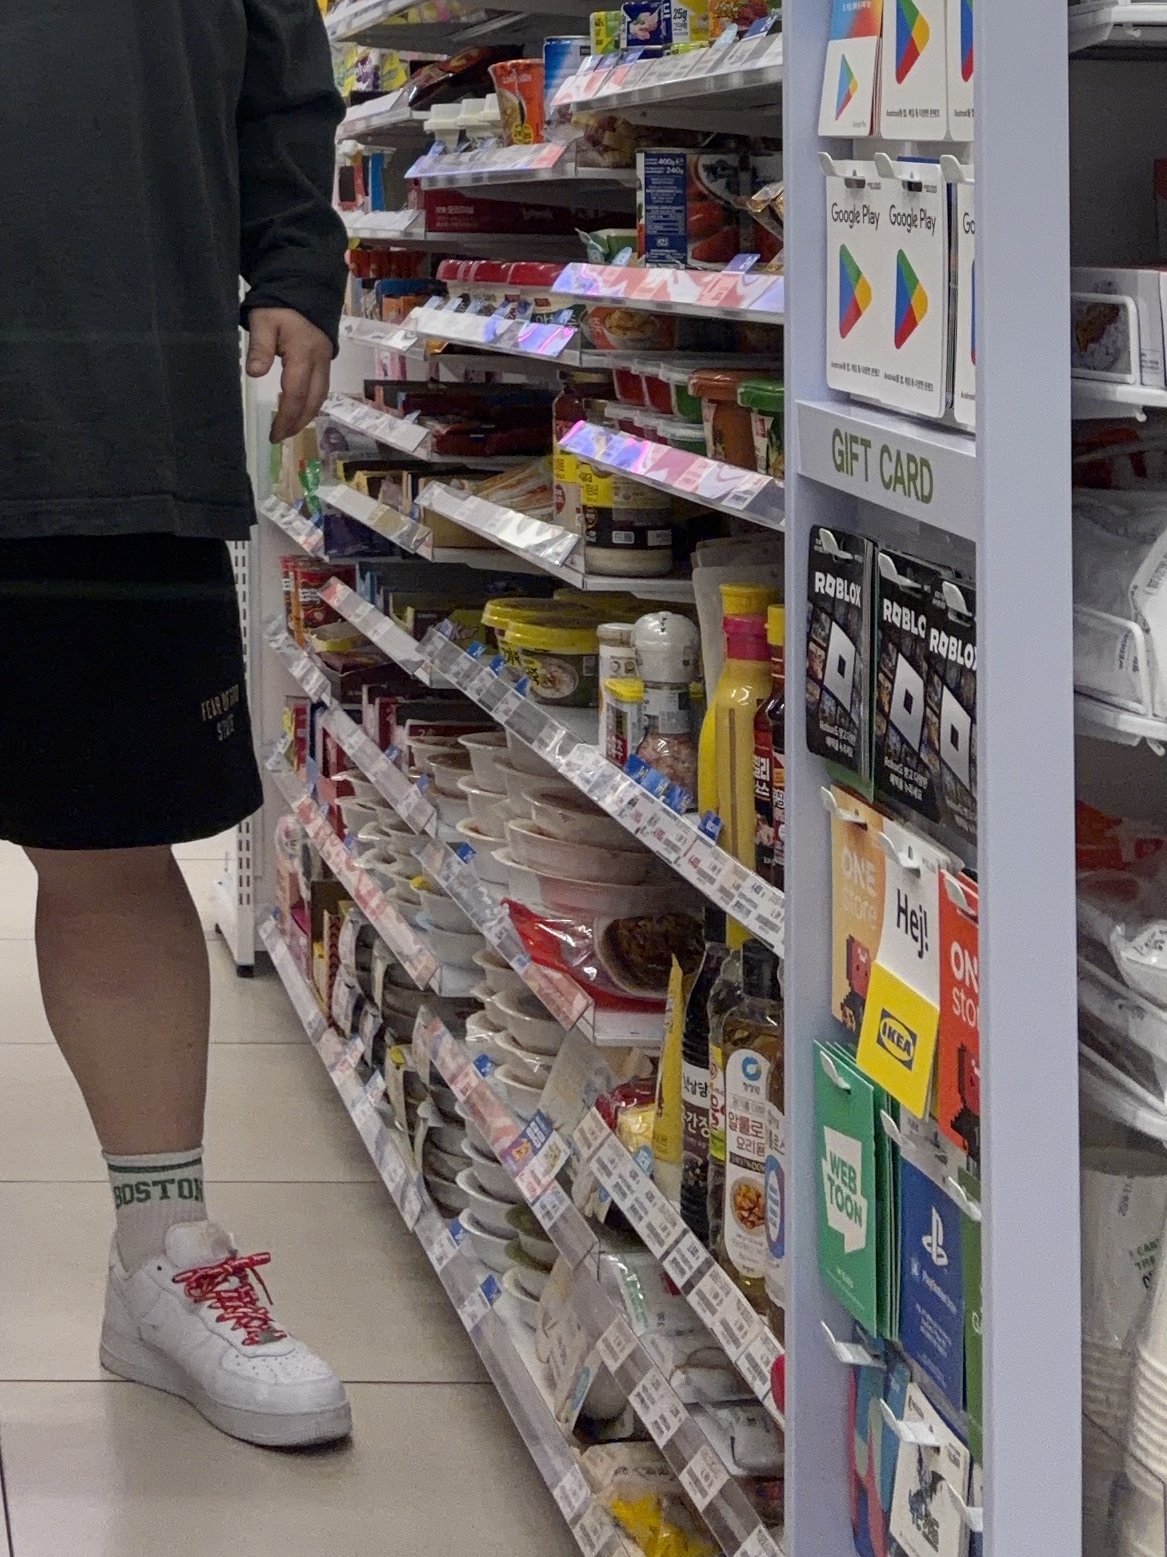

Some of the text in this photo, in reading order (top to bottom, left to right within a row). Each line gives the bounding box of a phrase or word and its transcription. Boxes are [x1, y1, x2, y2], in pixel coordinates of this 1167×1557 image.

[832, 202, 880, 231] Google Play
[889, 204, 918, 233] Google
[919, 208, 936, 236] Play
[831, 426, 935, 506] GIFT CARD
[814, 571, 861, 608] ROBLOX
[883, 598, 928, 640] ROBLO
[842, 842, 879, 897] ONE
[842, 889, 878, 933] store
[896, 887, 930, 956] Hej!
[950, 940, 979, 992] ON
[879, 1014, 917, 1056] IKEA
[728, 1111, 765, 1140] 알룰로
[114, 1176, 204, 1209] BOSTON
[829, 1151, 858, 1196] WEB
[826, 1172, 864, 1229] TOON
